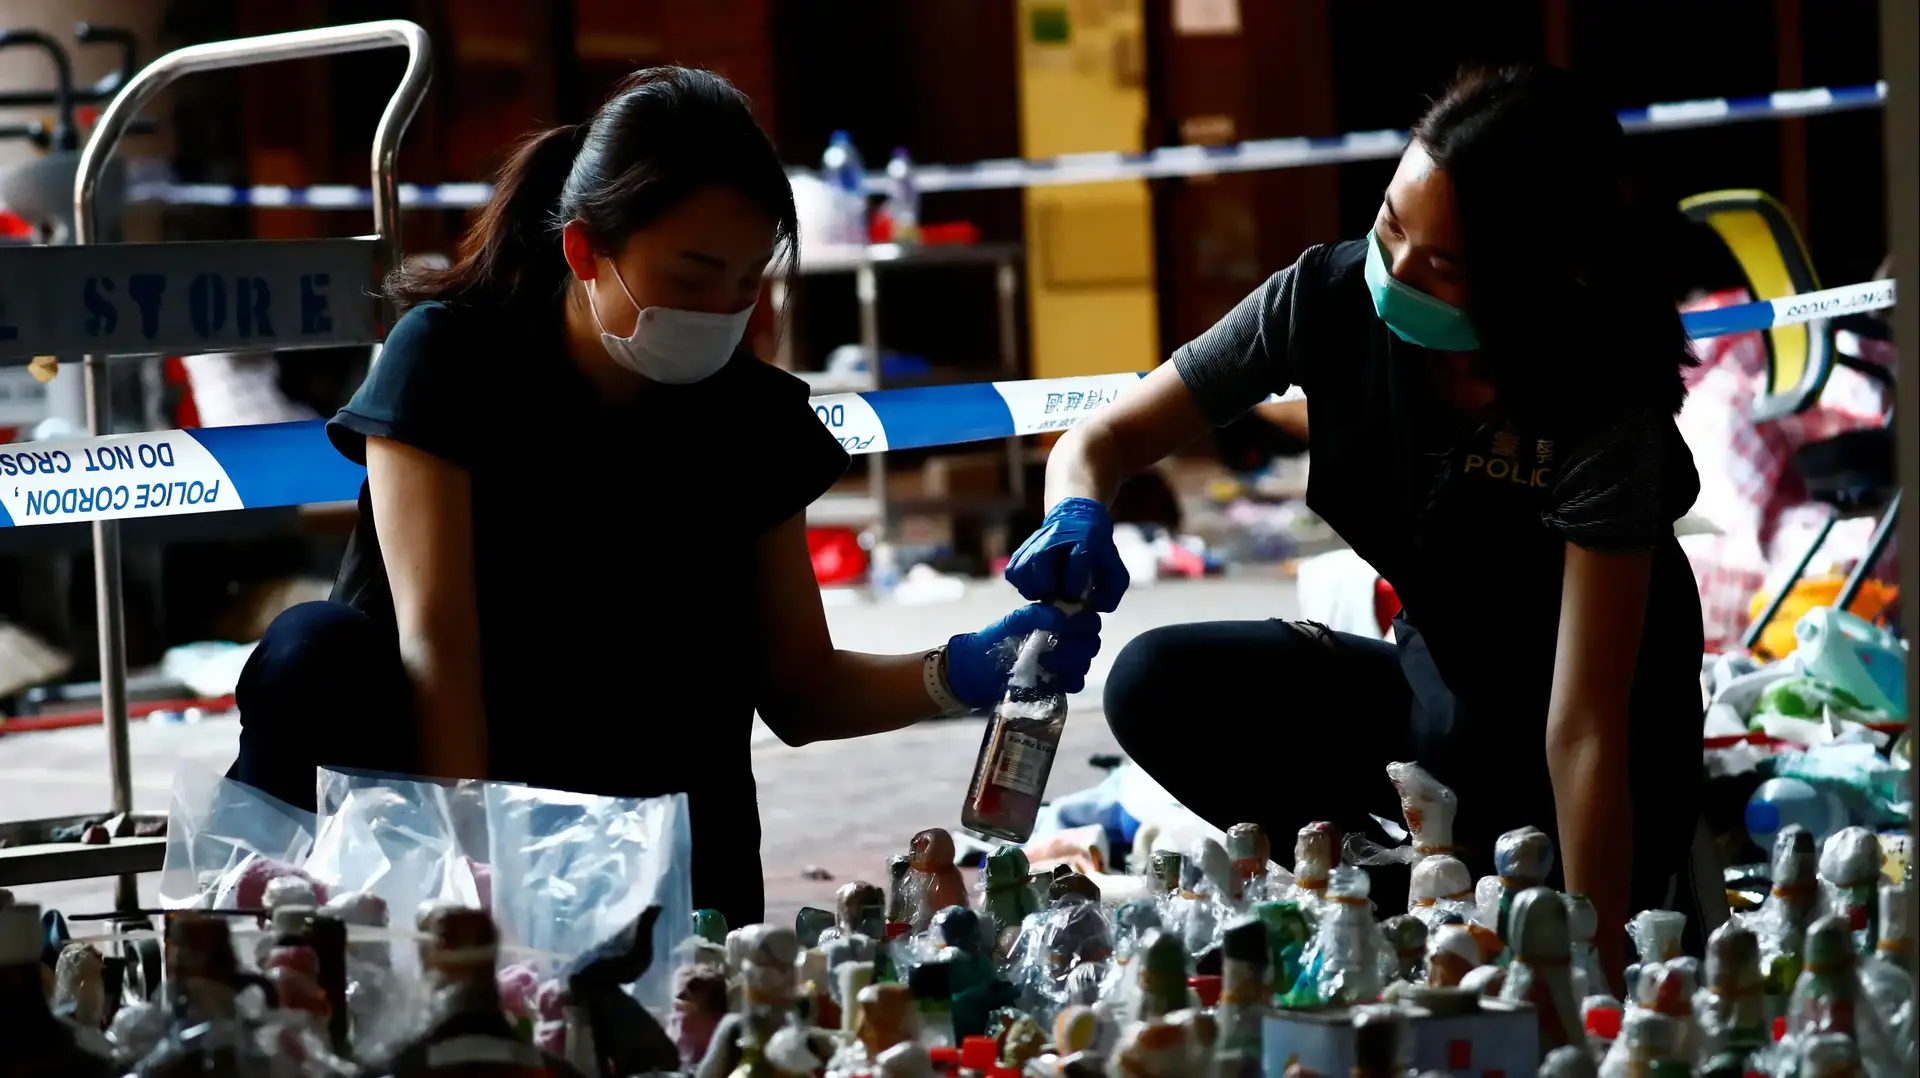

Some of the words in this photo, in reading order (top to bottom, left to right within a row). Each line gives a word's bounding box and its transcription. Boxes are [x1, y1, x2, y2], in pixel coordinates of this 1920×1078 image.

[83, 272, 333, 341] STORE
[815, 404, 844, 427] DO
[0, 450, 72, 476] CROS
[84, 445, 135, 472] NOT
[138, 442, 175, 468] DO
[1463, 453, 1553, 488] POLIC
[134, 479, 220, 509] POLICE
